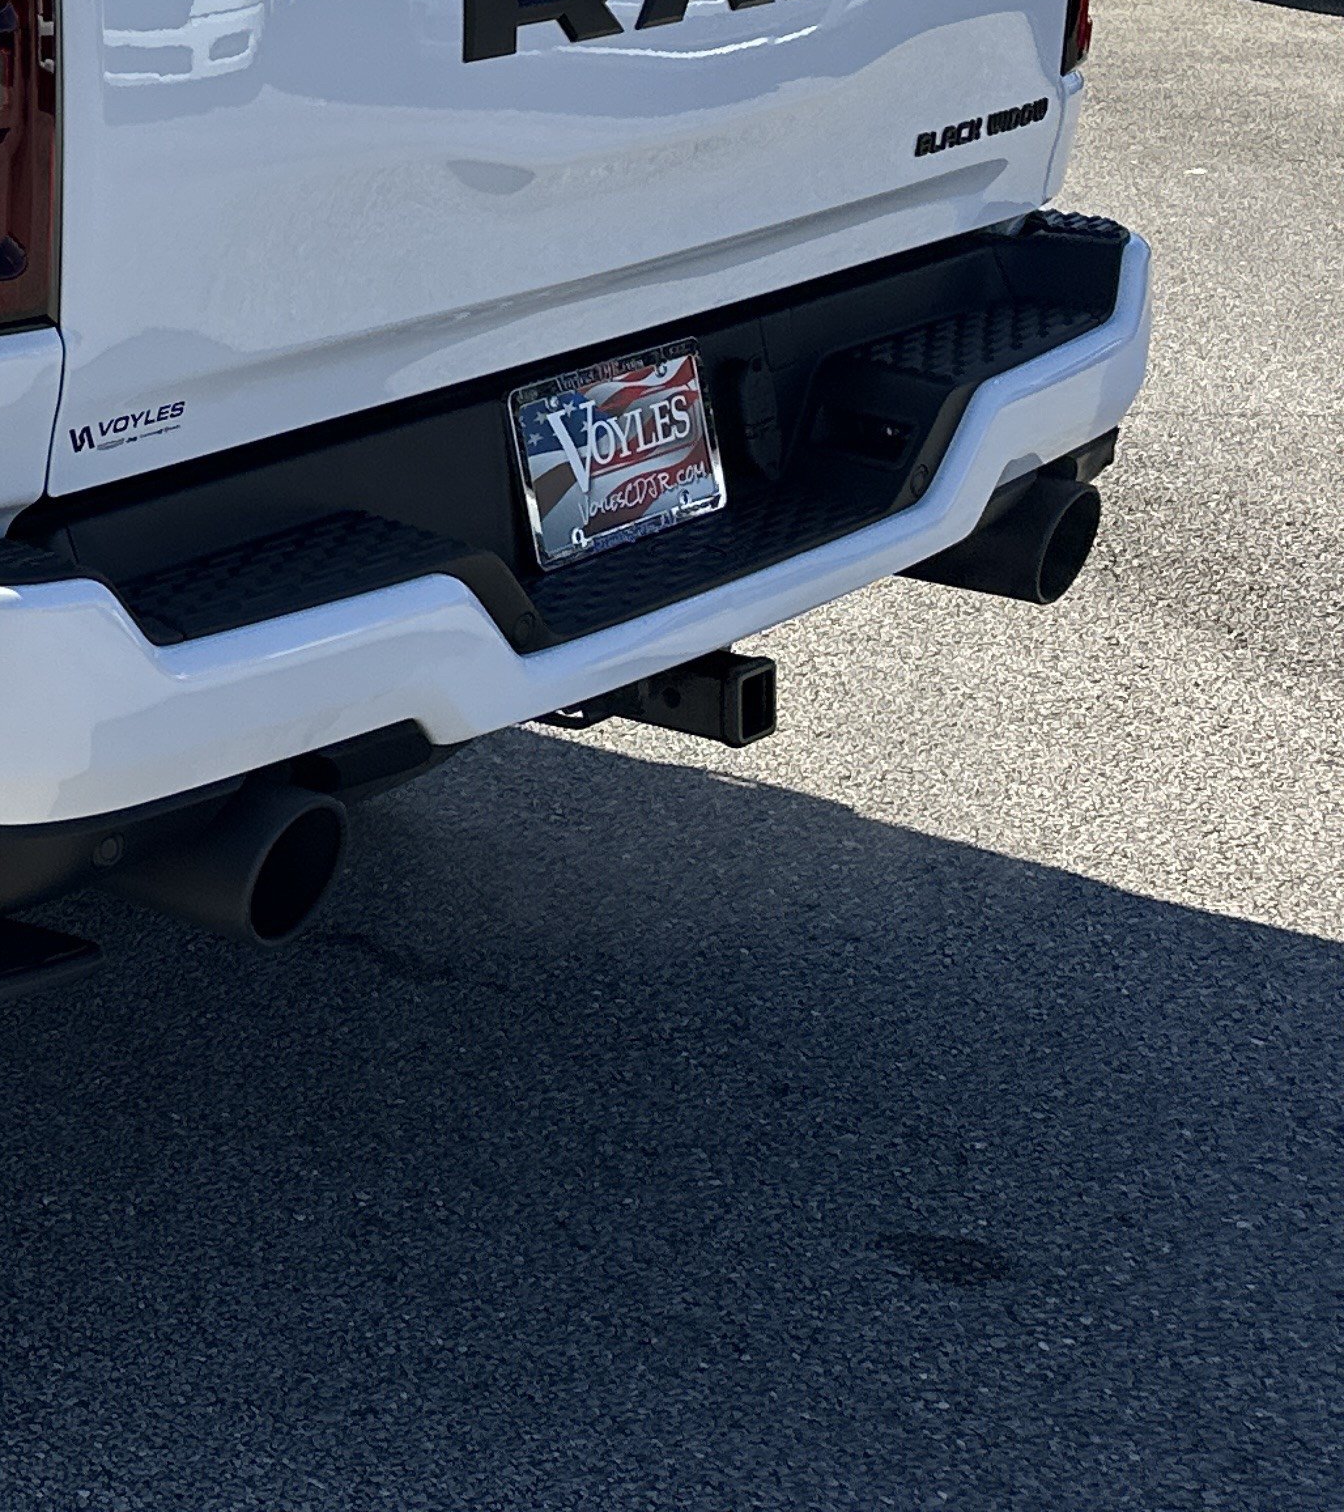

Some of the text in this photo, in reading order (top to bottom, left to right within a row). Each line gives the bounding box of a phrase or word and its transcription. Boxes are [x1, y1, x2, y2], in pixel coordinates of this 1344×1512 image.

[914, 97, 1049, 157] BLACK WIDOW
[98, 401, 186, 436] VOYLES
[547, 395, 691, 493] VOYLES
